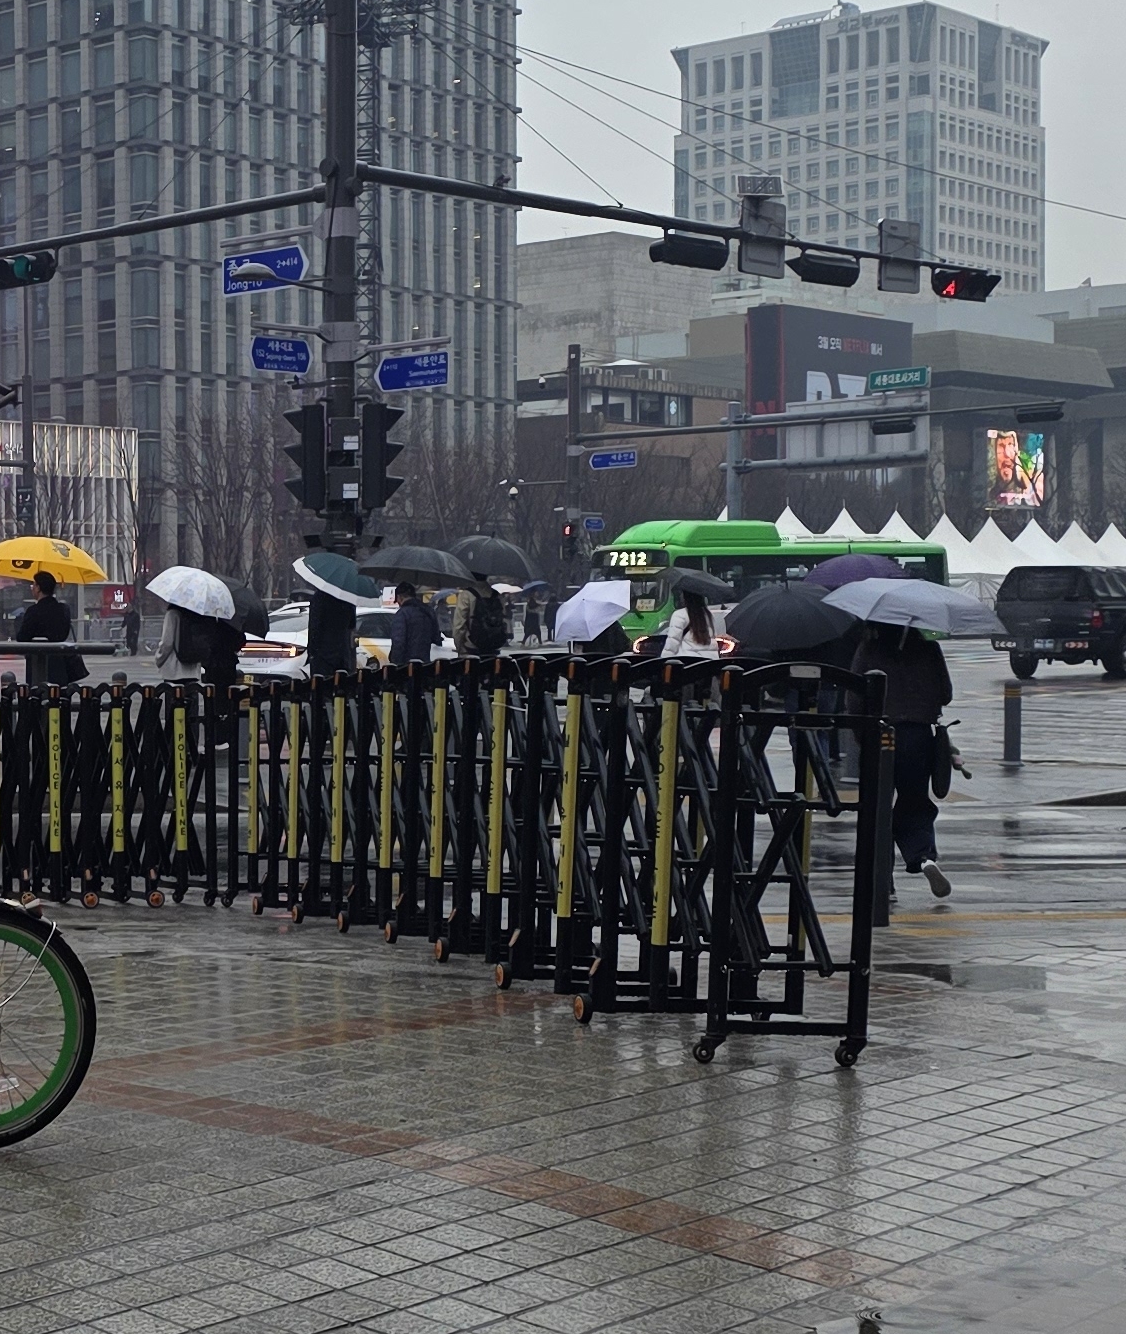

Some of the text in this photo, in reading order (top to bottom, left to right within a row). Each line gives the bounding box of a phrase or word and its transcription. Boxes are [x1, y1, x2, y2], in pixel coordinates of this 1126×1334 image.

[874, 370, 921, 386] 세종대로사거리
[609, 551, 647, 566] 7212
[52, 733, 61, 790] POLICE
[177, 733, 185, 789] POLICE
